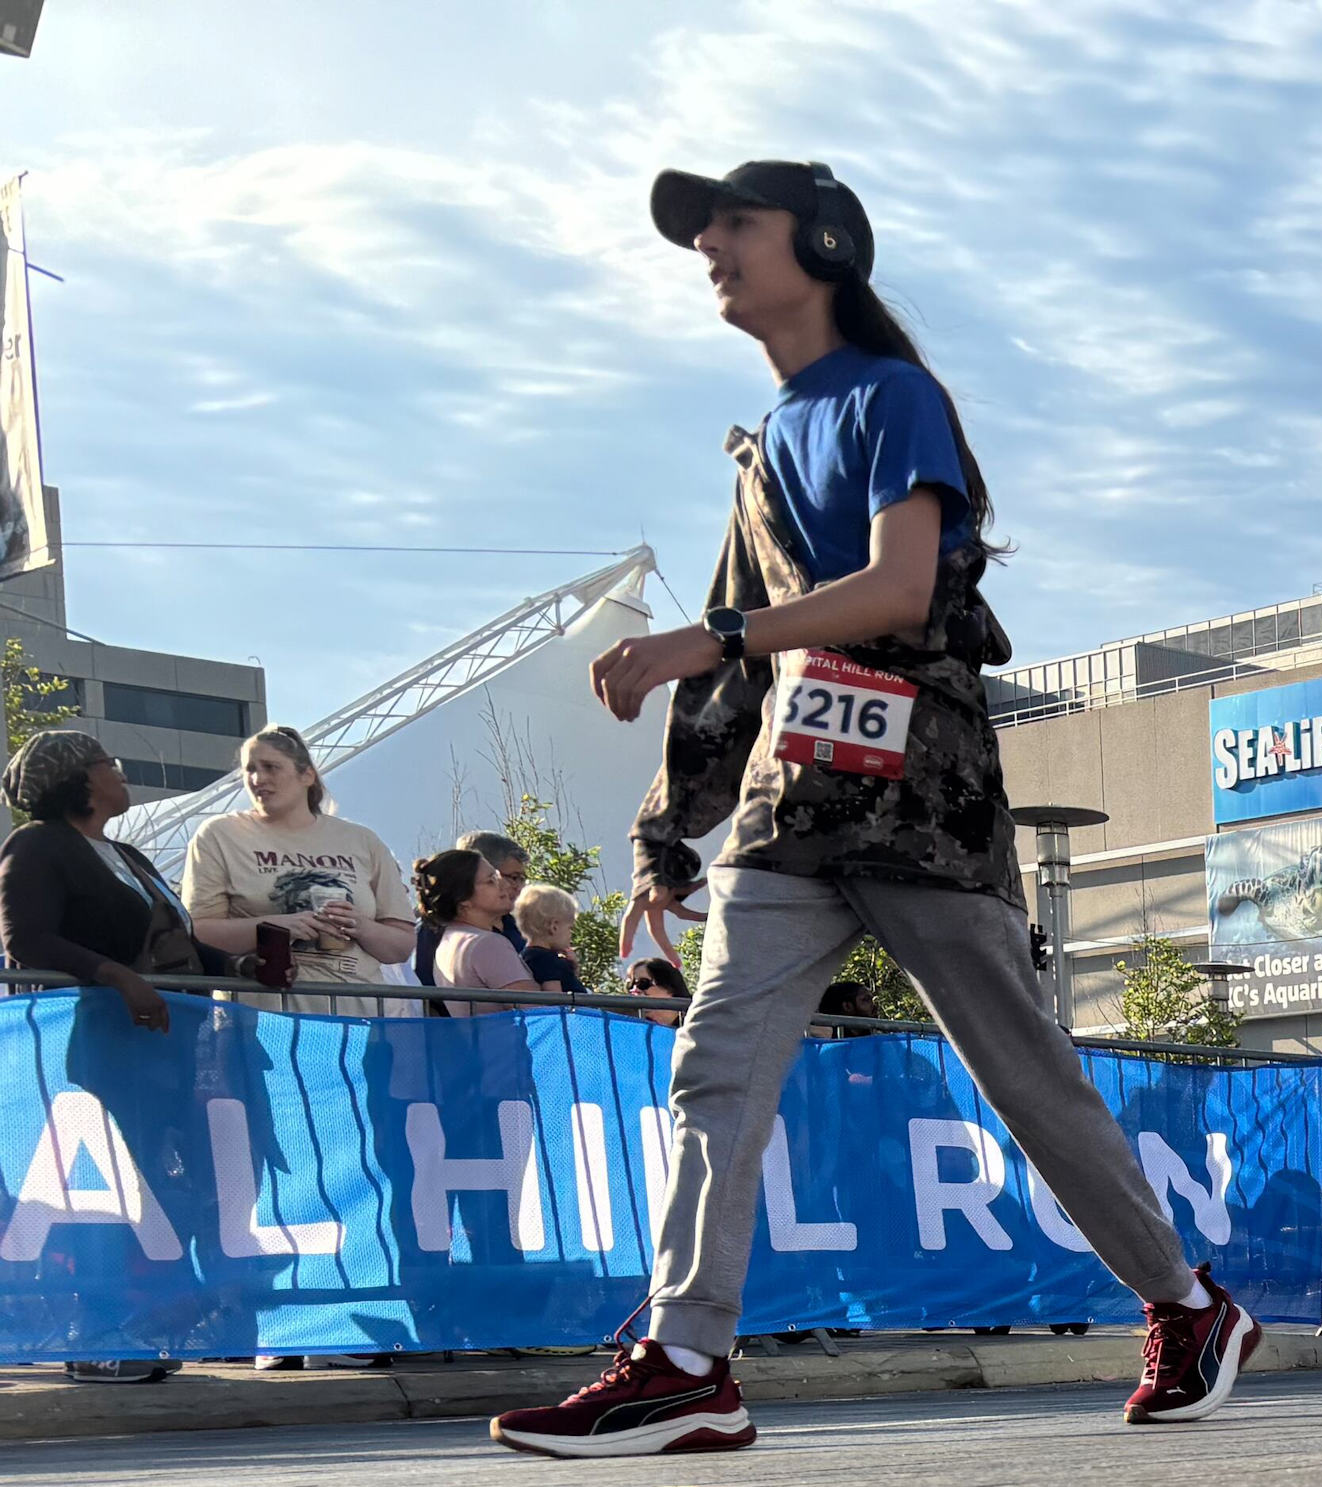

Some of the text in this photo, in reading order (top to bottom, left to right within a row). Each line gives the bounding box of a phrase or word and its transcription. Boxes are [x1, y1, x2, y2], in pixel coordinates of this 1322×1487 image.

[841, 662, 872, 677] HILL
[874, 669, 905, 684] RUN
[1214, 725, 1279, 790] SEA
[253, 850, 356, 873] MANON
[1253, 953, 1310, 978] Closer
